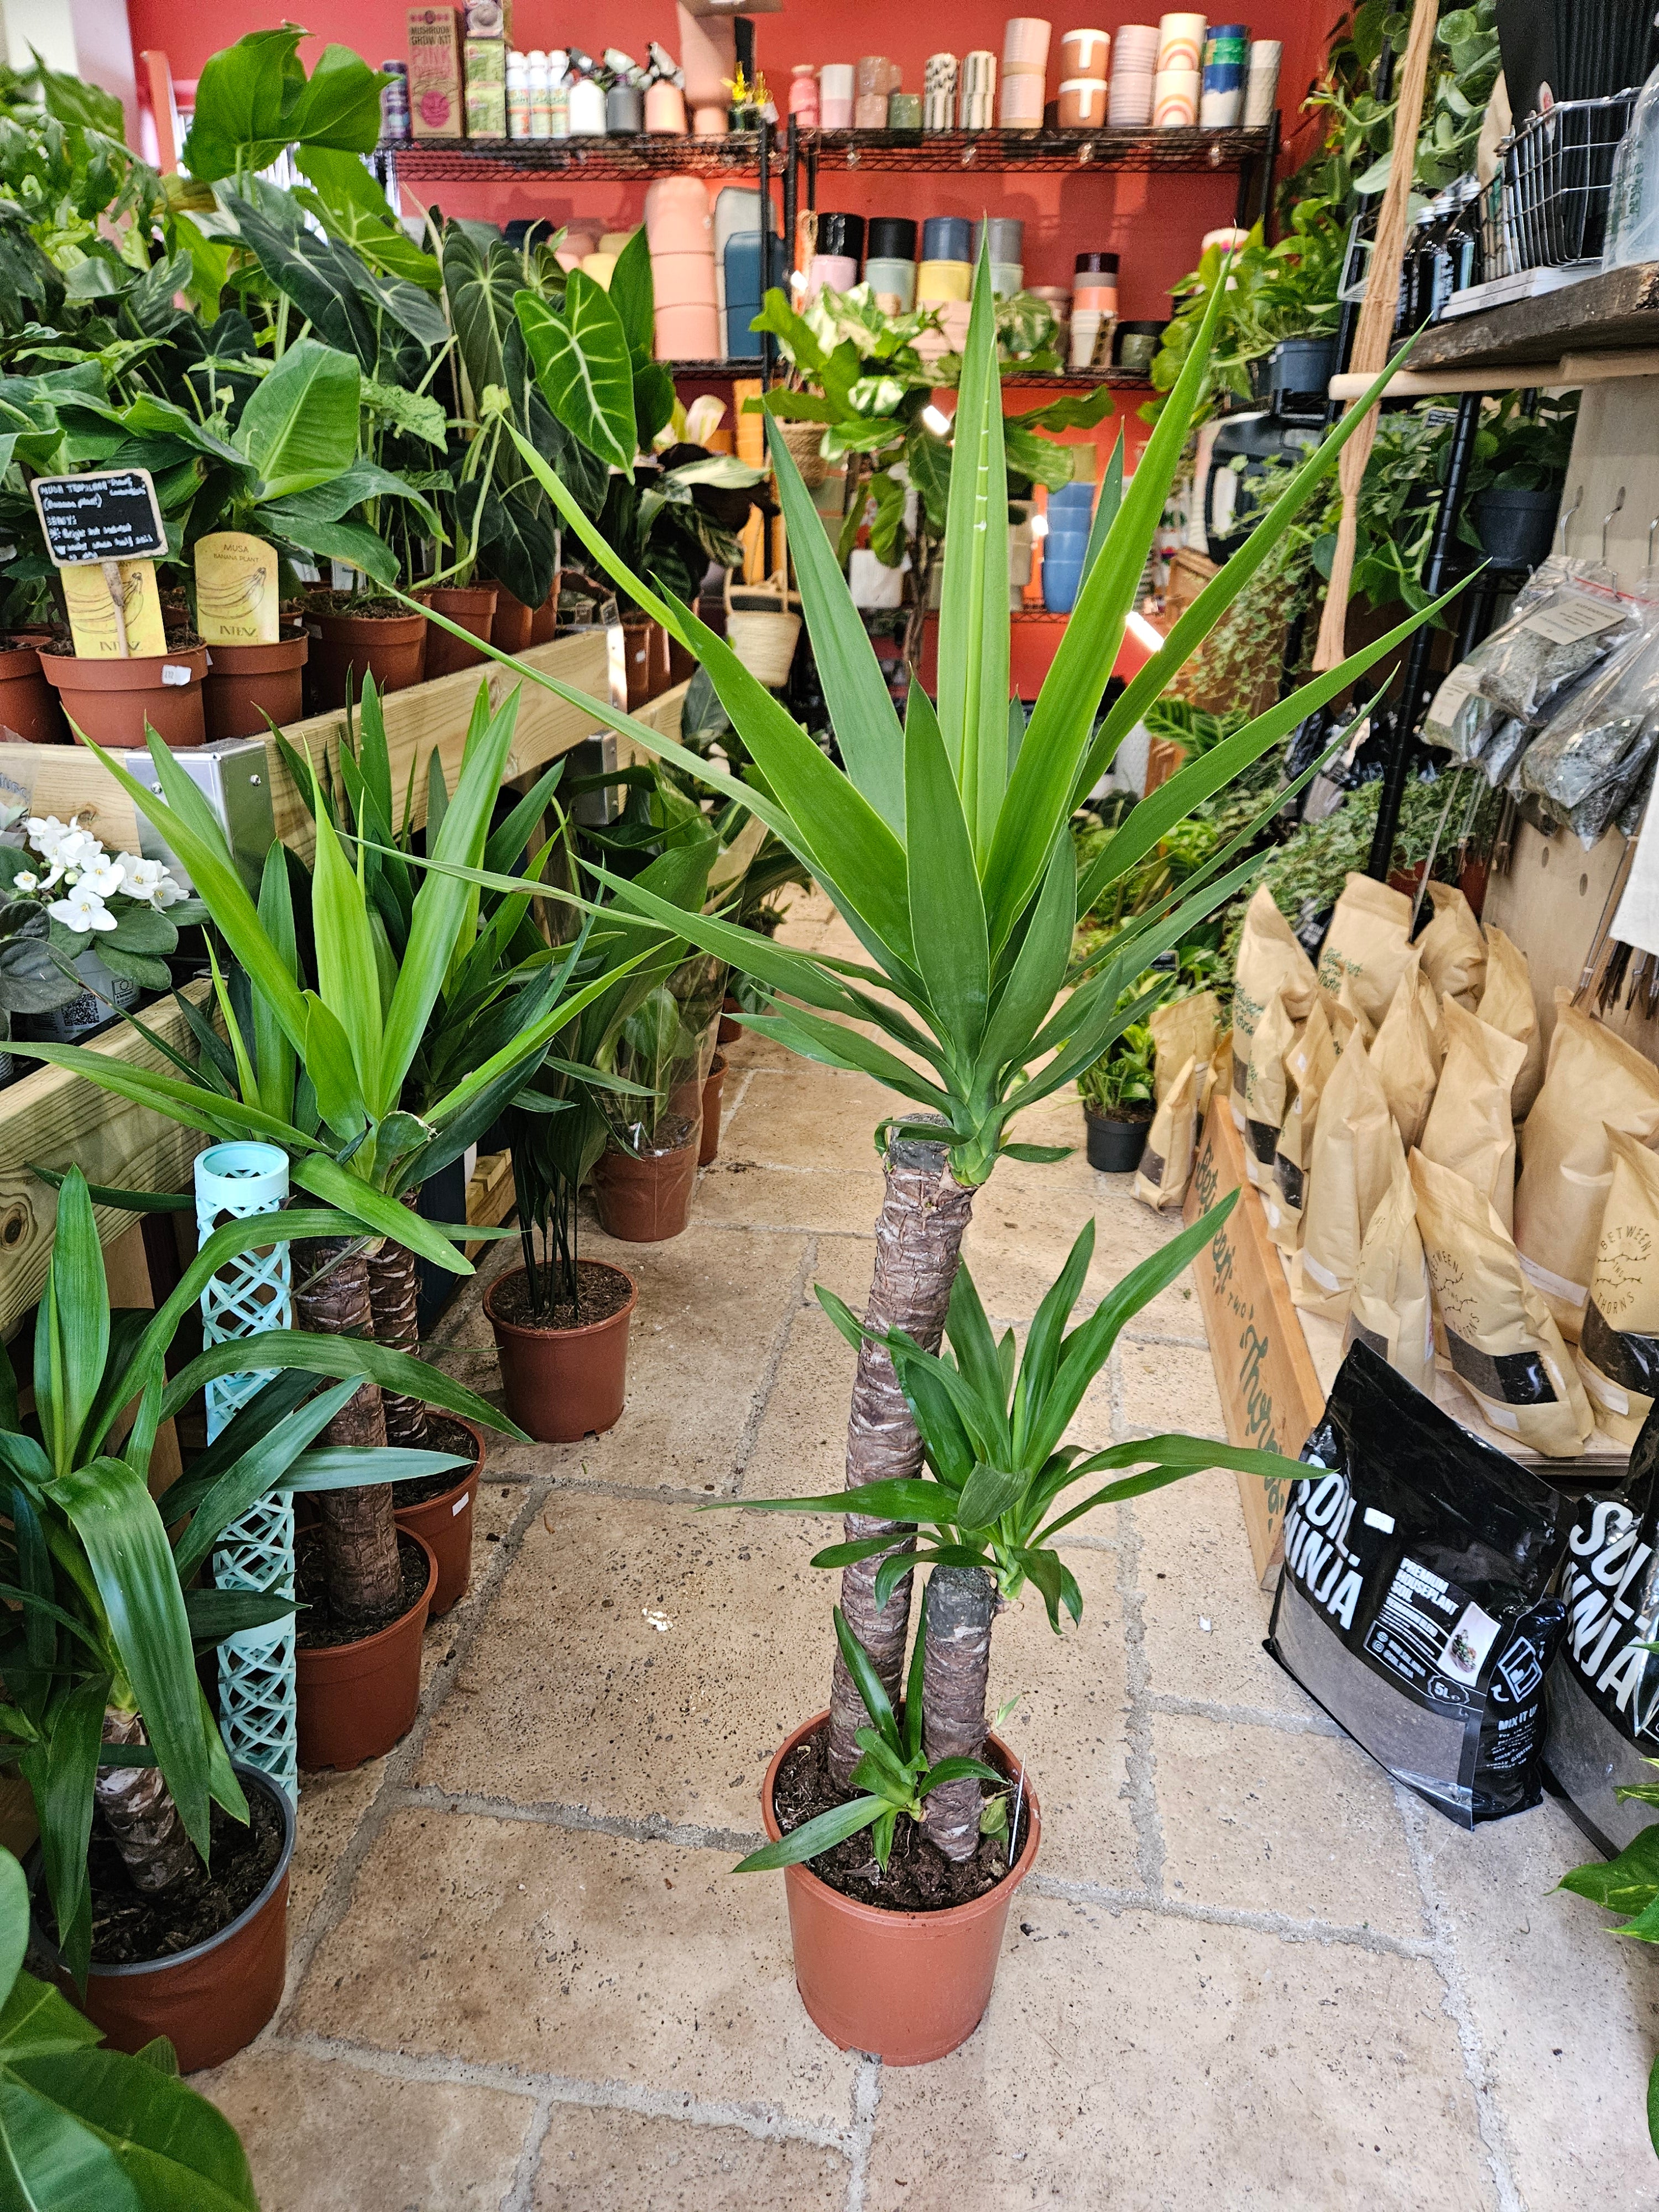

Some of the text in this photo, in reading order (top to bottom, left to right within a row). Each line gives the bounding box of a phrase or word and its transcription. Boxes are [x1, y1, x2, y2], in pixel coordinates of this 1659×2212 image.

[411, 25, 450, 34] MUSHROOM
[411, 34, 451, 45] GROW KIT
[213, 553, 238, 561] BANANA
[223, 544, 249, 552] MUSA
[1600, 1225, 1652, 1253] BETWEEN
[1613, 1261, 1624, 1278] TWO
[1597, 1291, 1635, 1314] THORNS
[1453, 1312, 1480, 1339] THORNS
[1400, 1557, 1449, 1594] PREMIUM
[1390, 1580, 1414, 1603] SOIL
[1395, 1569, 1459, 1615] HOUSEPLANT
[1498, 1716, 1518, 1731] MIX
[1519, 1710, 1528, 1723] IT
[1511, 1743, 1533, 1762] dispersed
